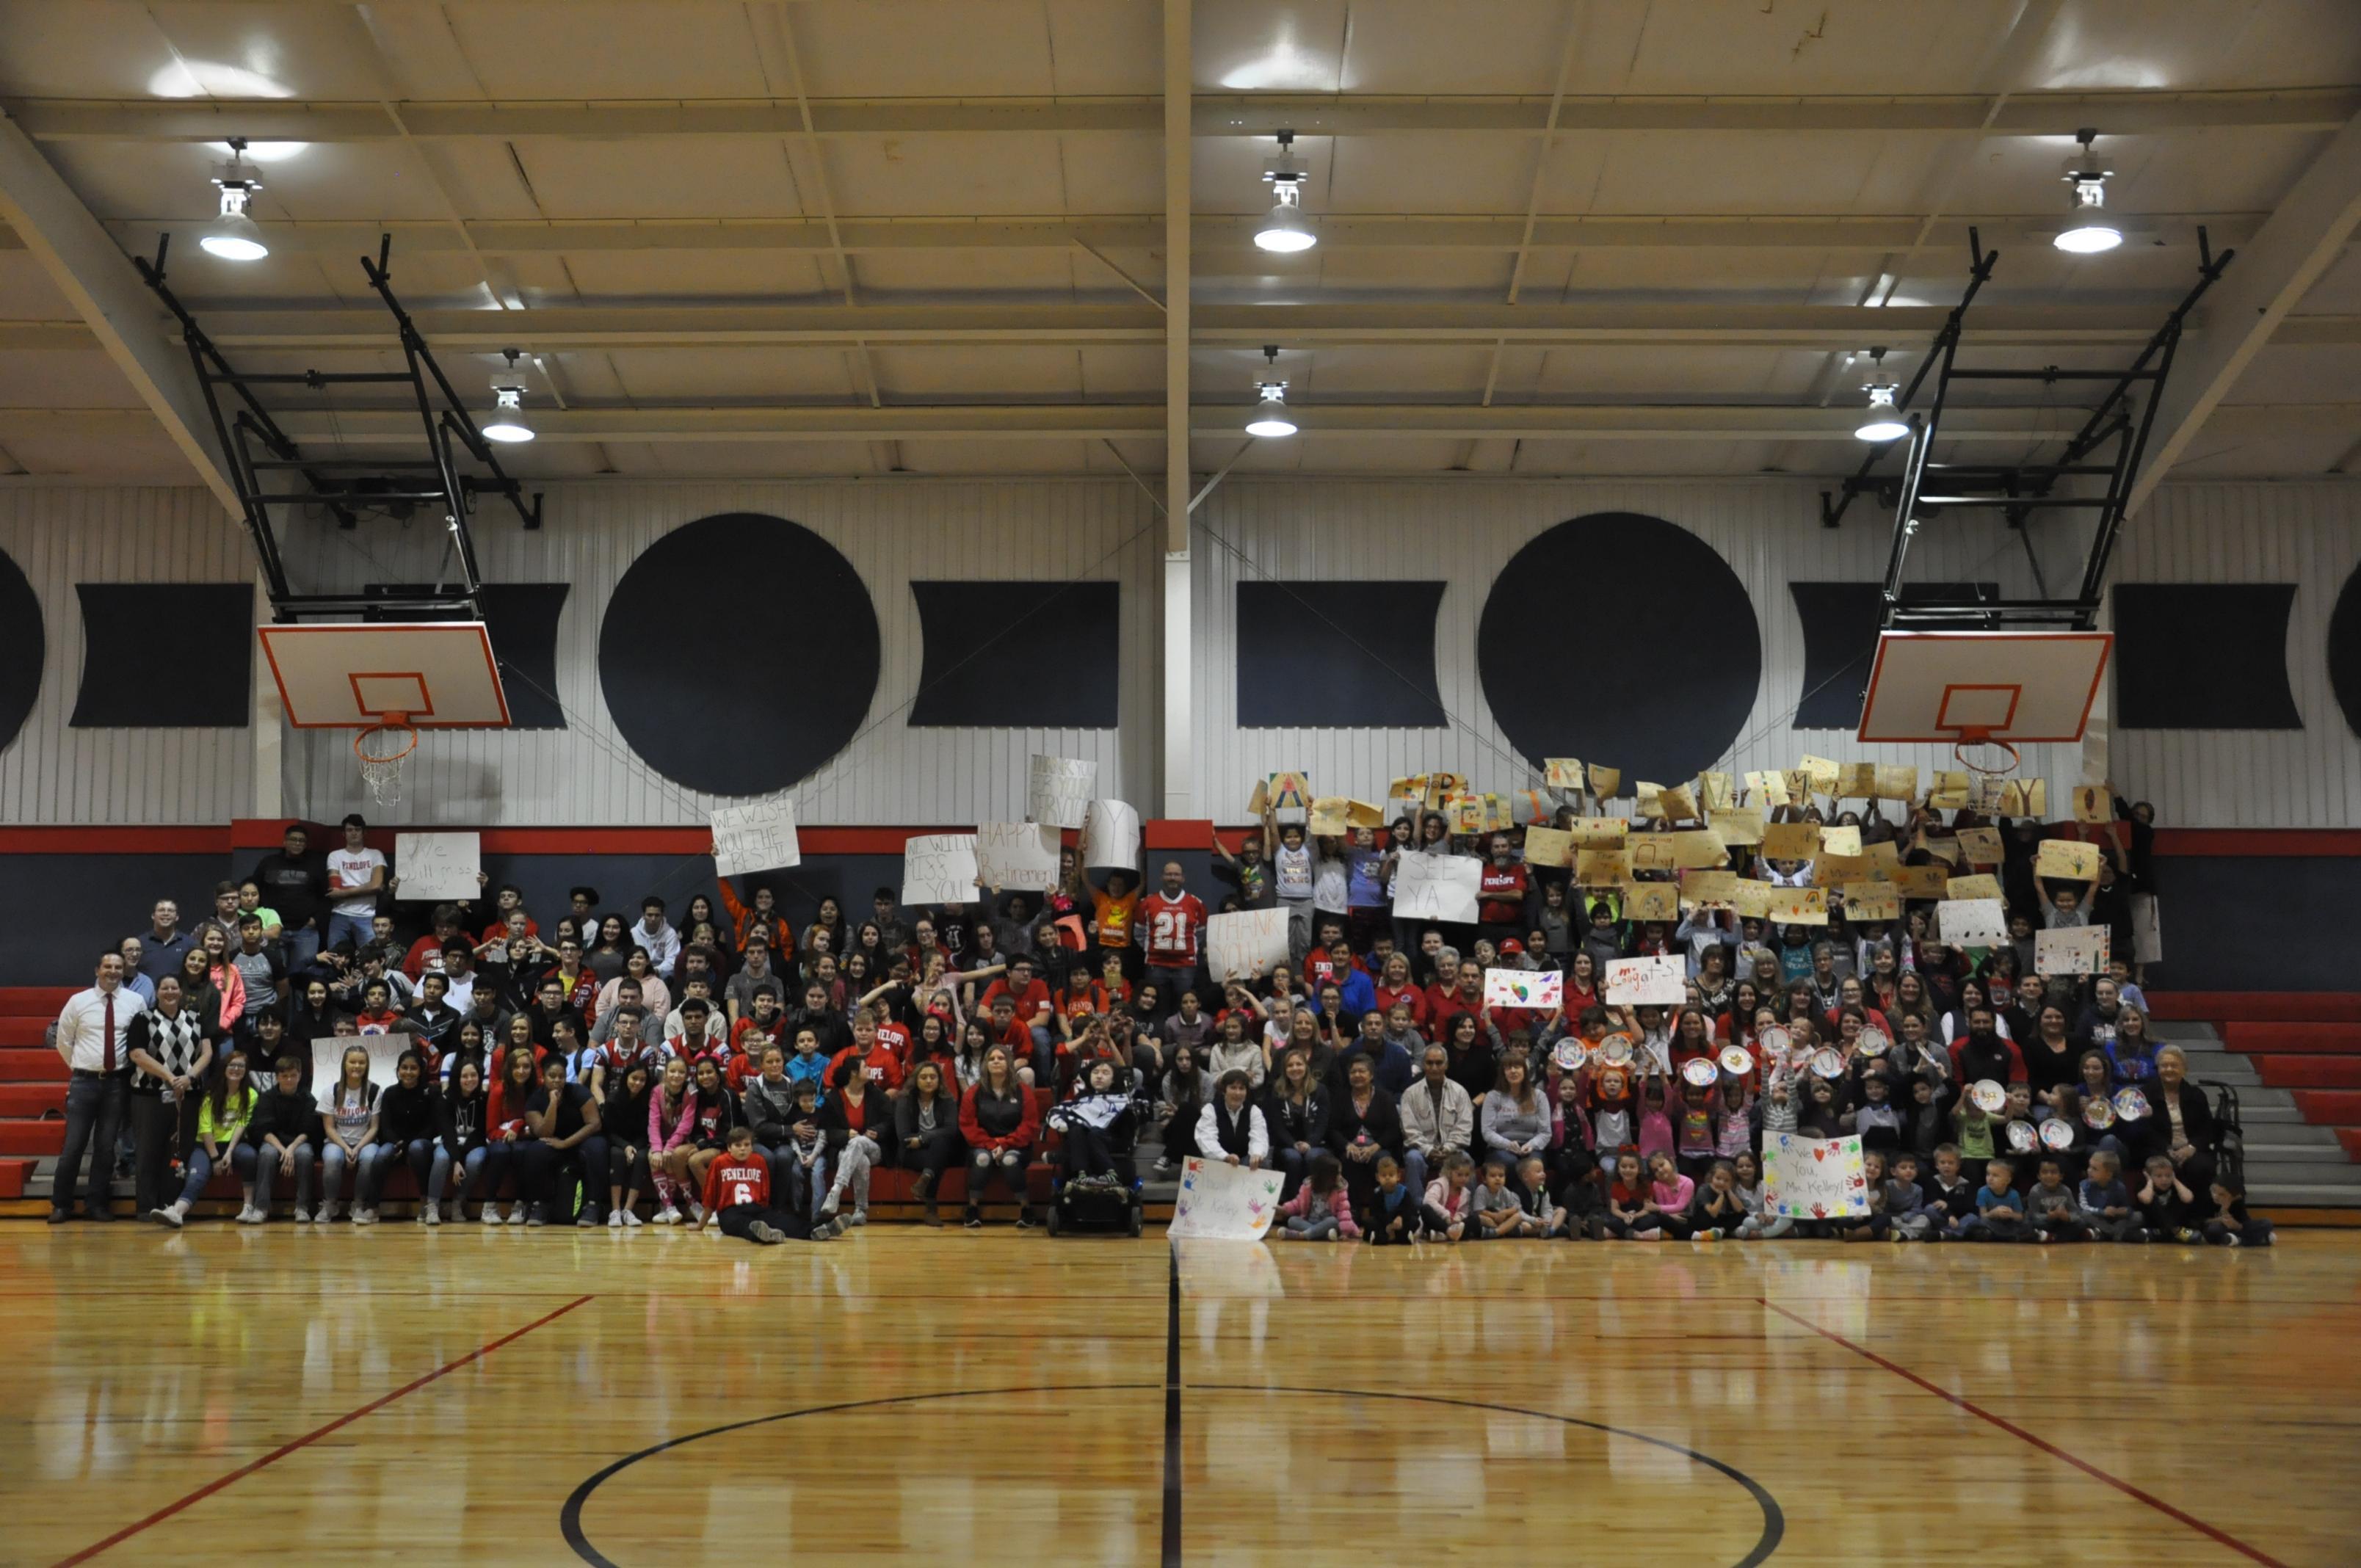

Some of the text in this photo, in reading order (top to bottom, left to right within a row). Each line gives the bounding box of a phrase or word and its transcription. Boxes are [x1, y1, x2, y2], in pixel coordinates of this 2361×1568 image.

[2014, 778, 2037, 816] Y
[711, 802, 788, 828] WE WISH
[715, 825, 784, 854] YOU THE
[907, 838, 924, 854] WE
[979, 822, 1038, 848] HAPPY
[342, 860, 371, 870] PENELOPE
[906, 854, 948, 882] MISS
[980, 853, 1060, 883] Retirement
[1410, 852, 1457, 880] SEE
[926, 879, 963, 902] YOU
[1407, 885, 1440, 911] YA
[1153, 911, 1187, 950] 21
[1216, 910, 1280, 940] THANK
[1796, 1147, 1812, 1158] We
[720, 1168, 762, 1183] PENELOPE
[1807, 1179, 1844, 1197] Kelley!
[735, 1183, 752, 1205] 6
